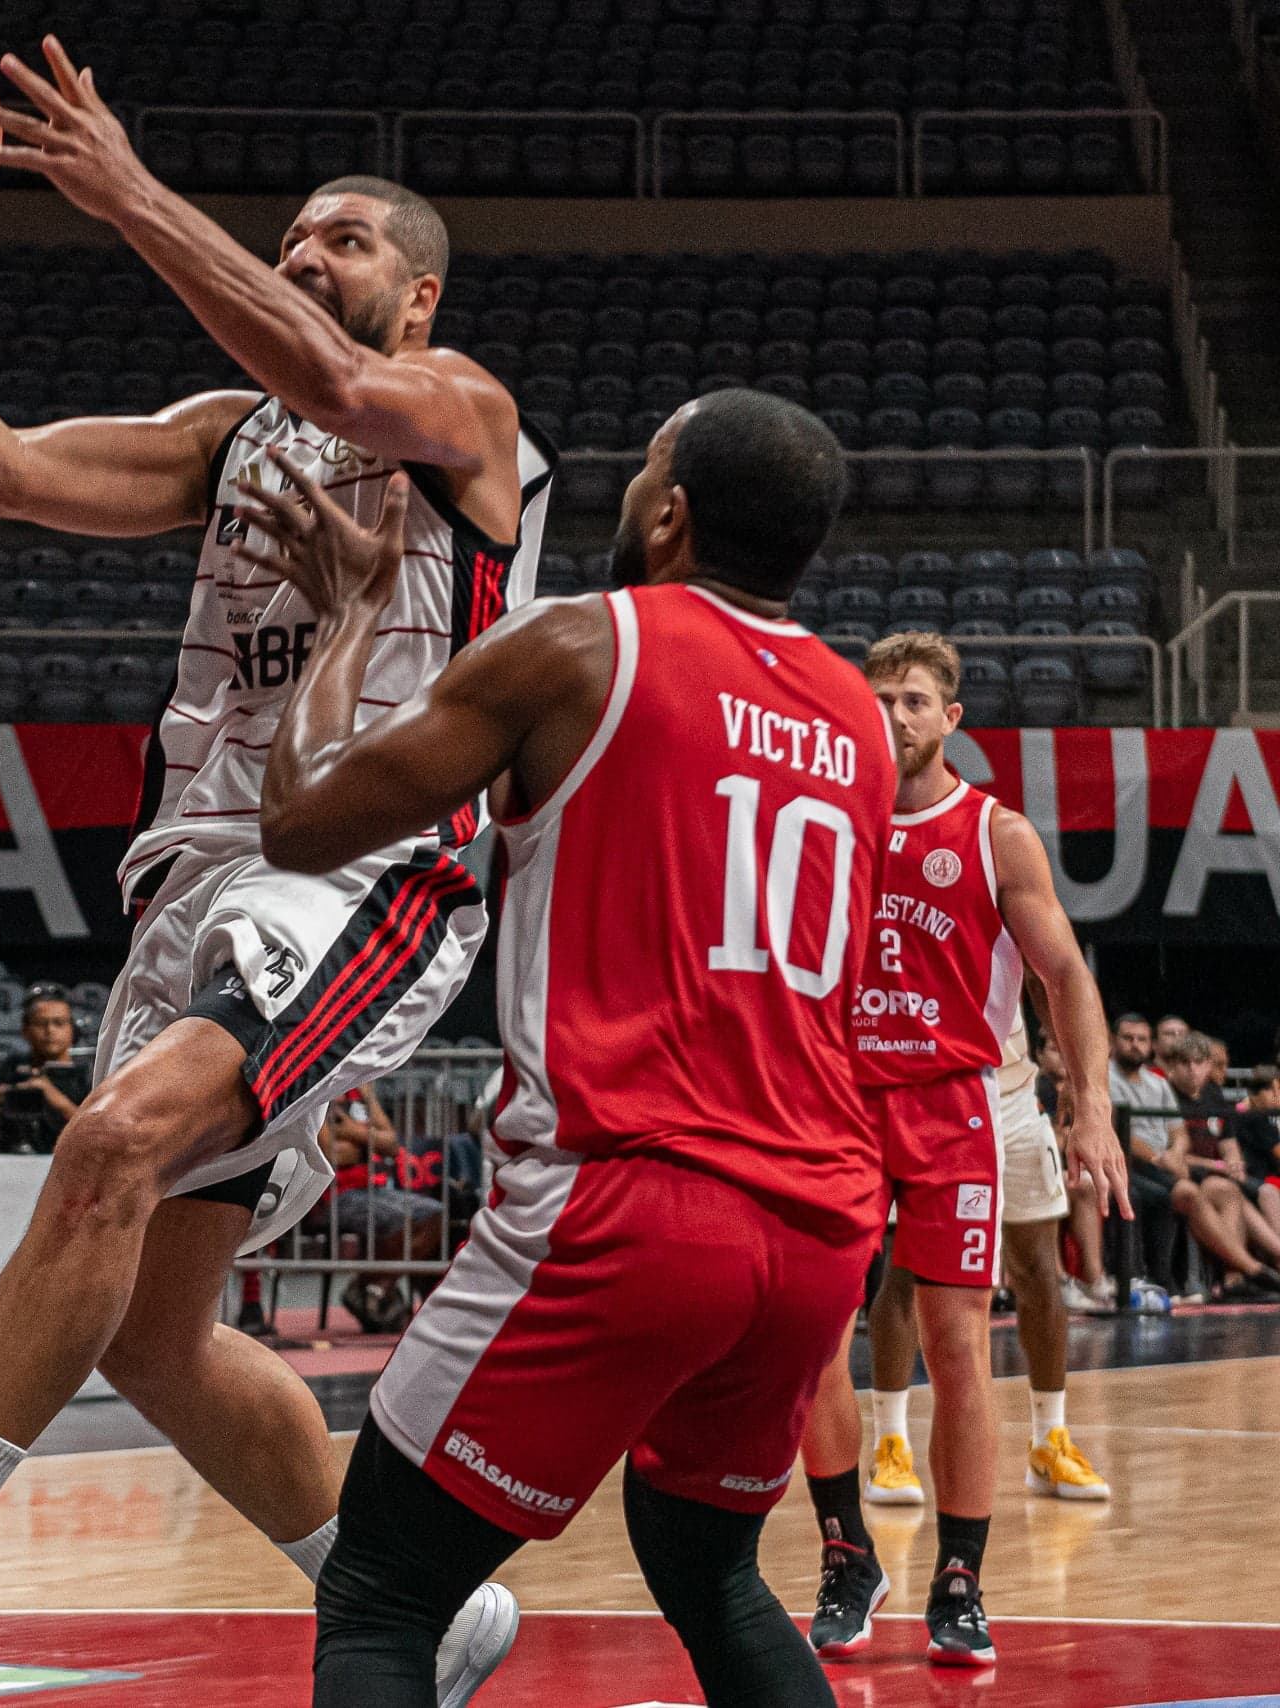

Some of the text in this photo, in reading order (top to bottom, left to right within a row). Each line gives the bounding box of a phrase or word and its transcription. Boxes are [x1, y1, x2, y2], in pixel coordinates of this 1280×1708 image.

[719, 692, 856, 787] VICTÃO
[942, 727, 1280, 922] UA
[708, 774, 856, 999] 10
[880, 928, 903, 973] 2
[960, 1228, 986, 1272] 2
[444, 1436, 576, 1511] BRASANITAS
